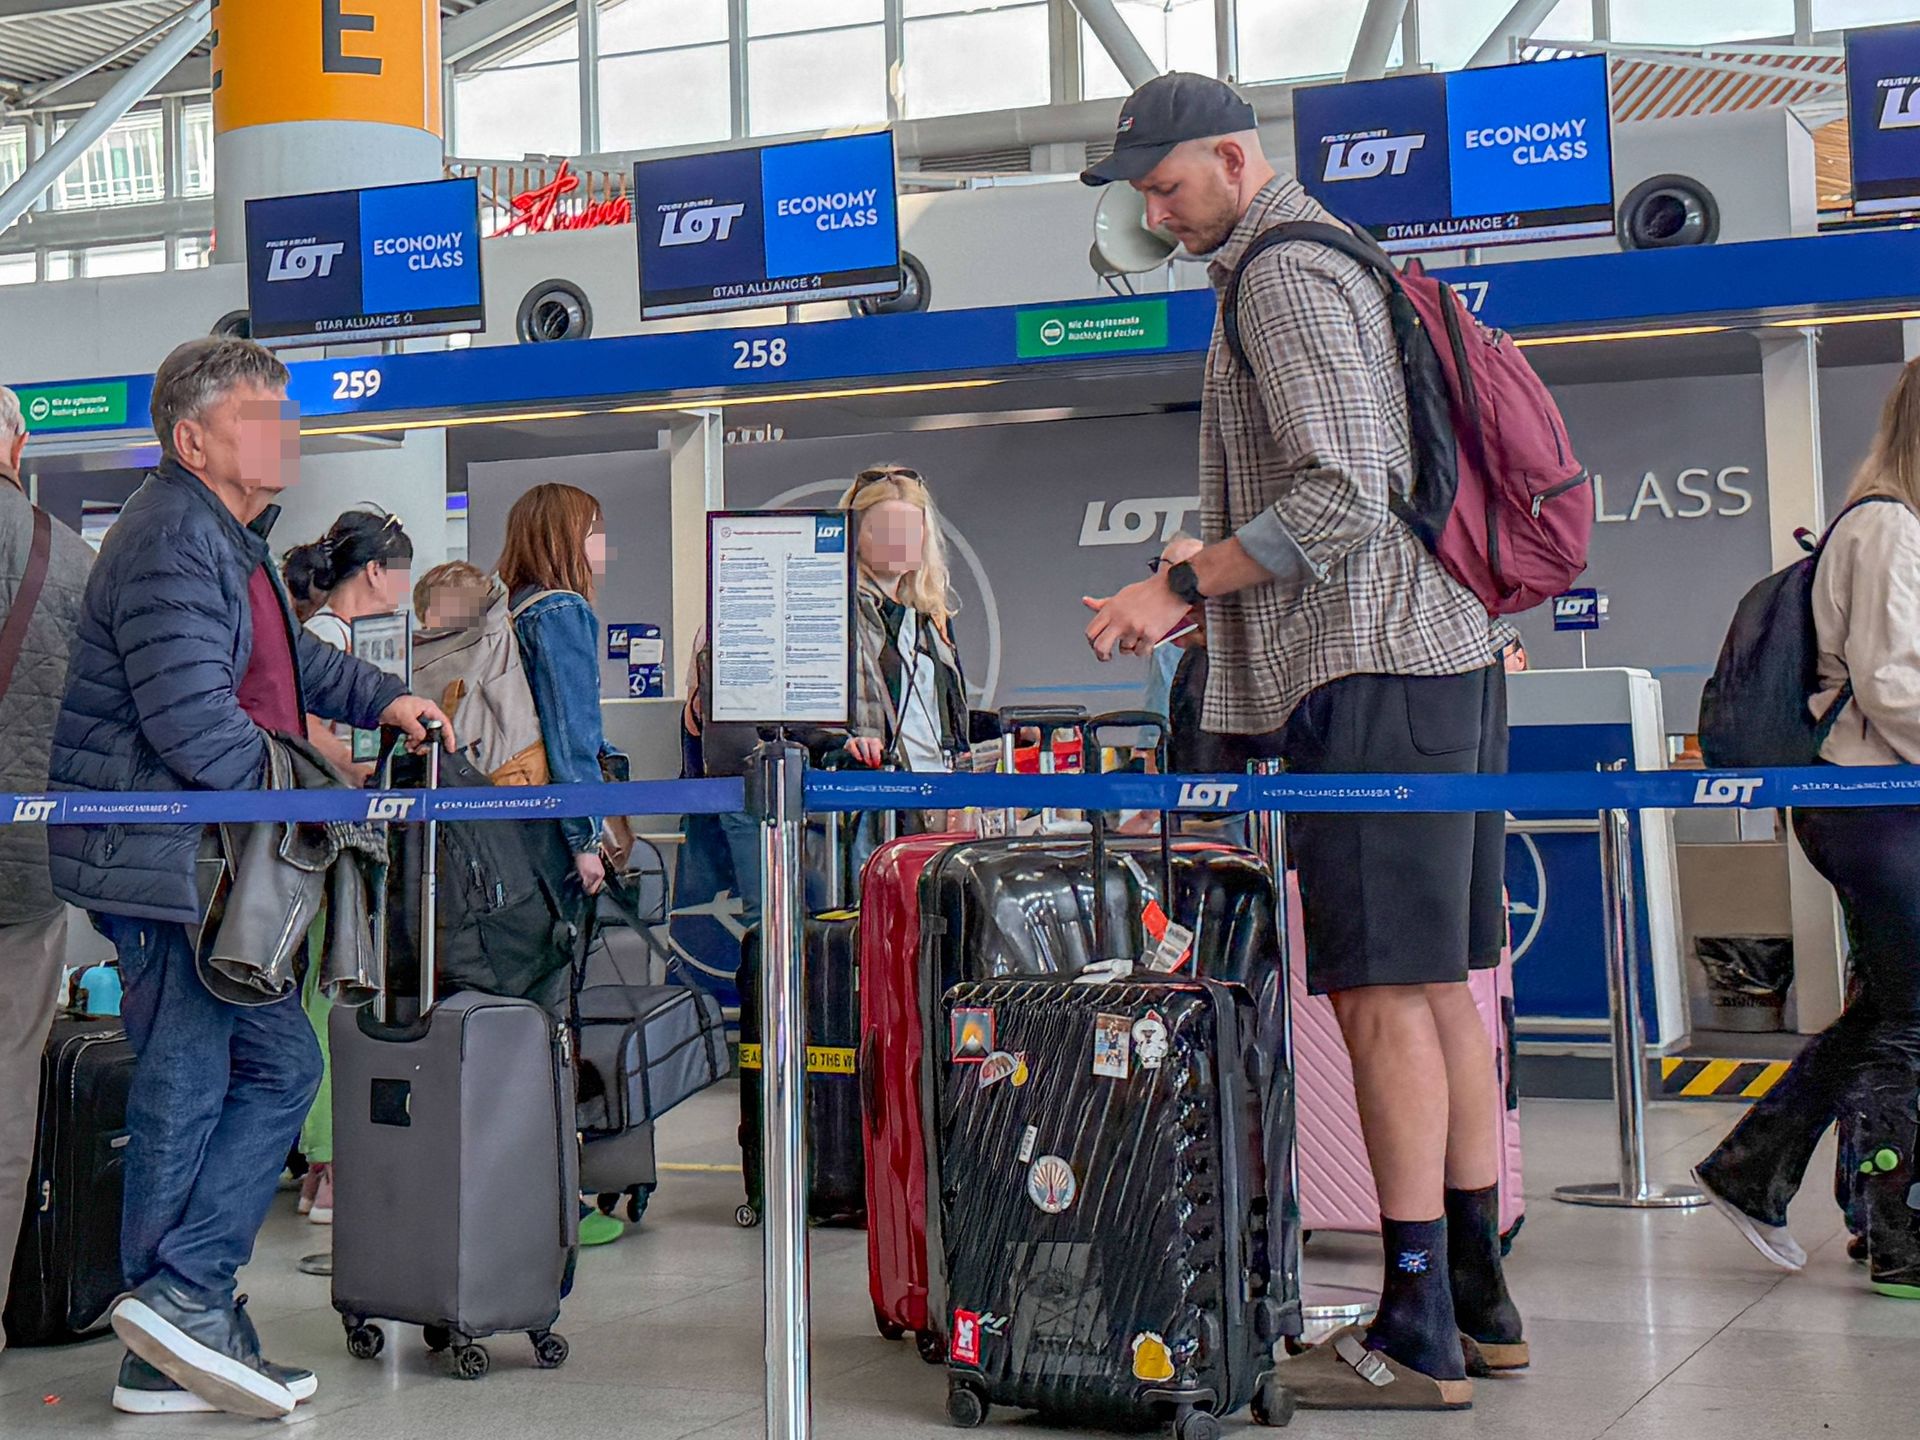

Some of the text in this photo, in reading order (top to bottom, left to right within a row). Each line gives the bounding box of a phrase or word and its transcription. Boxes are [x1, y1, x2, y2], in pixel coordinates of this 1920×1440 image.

[322, 0, 381, 75] E
[1465, 118, 1586, 149] ECONOMY
[1323, 134, 1426, 182] LOT
[1512, 141, 1588, 165] CLASS
[777, 189, 877, 216] ECONOMY
[659, 203, 745, 247] LOT
[816, 209, 878, 231] CLASS
[1387, 217, 1502, 239] STAR ALLIANCE
[374, 232, 463, 256] ECONOMY
[267, 242, 344, 281] LOT
[408, 251, 464, 271] CLASS
[747, 278, 808, 294] ALLIANCE
[1450, 281, 1489, 312] 57
[733, 338, 787, 369] 258
[333, 369, 381, 399] 259
[1594, 467, 1752, 522] LASS
[817, 527, 843, 538] LOT
[1079, 496, 1200, 546] LOT
[1556, 598, 1596, 616] LOT
[1178, 783, 1239, 807] LOT
[1694, 778, 1764, 803] LOT
[13, 801, 57, 822] LOT
[366, 798, 415, 819] LOT
